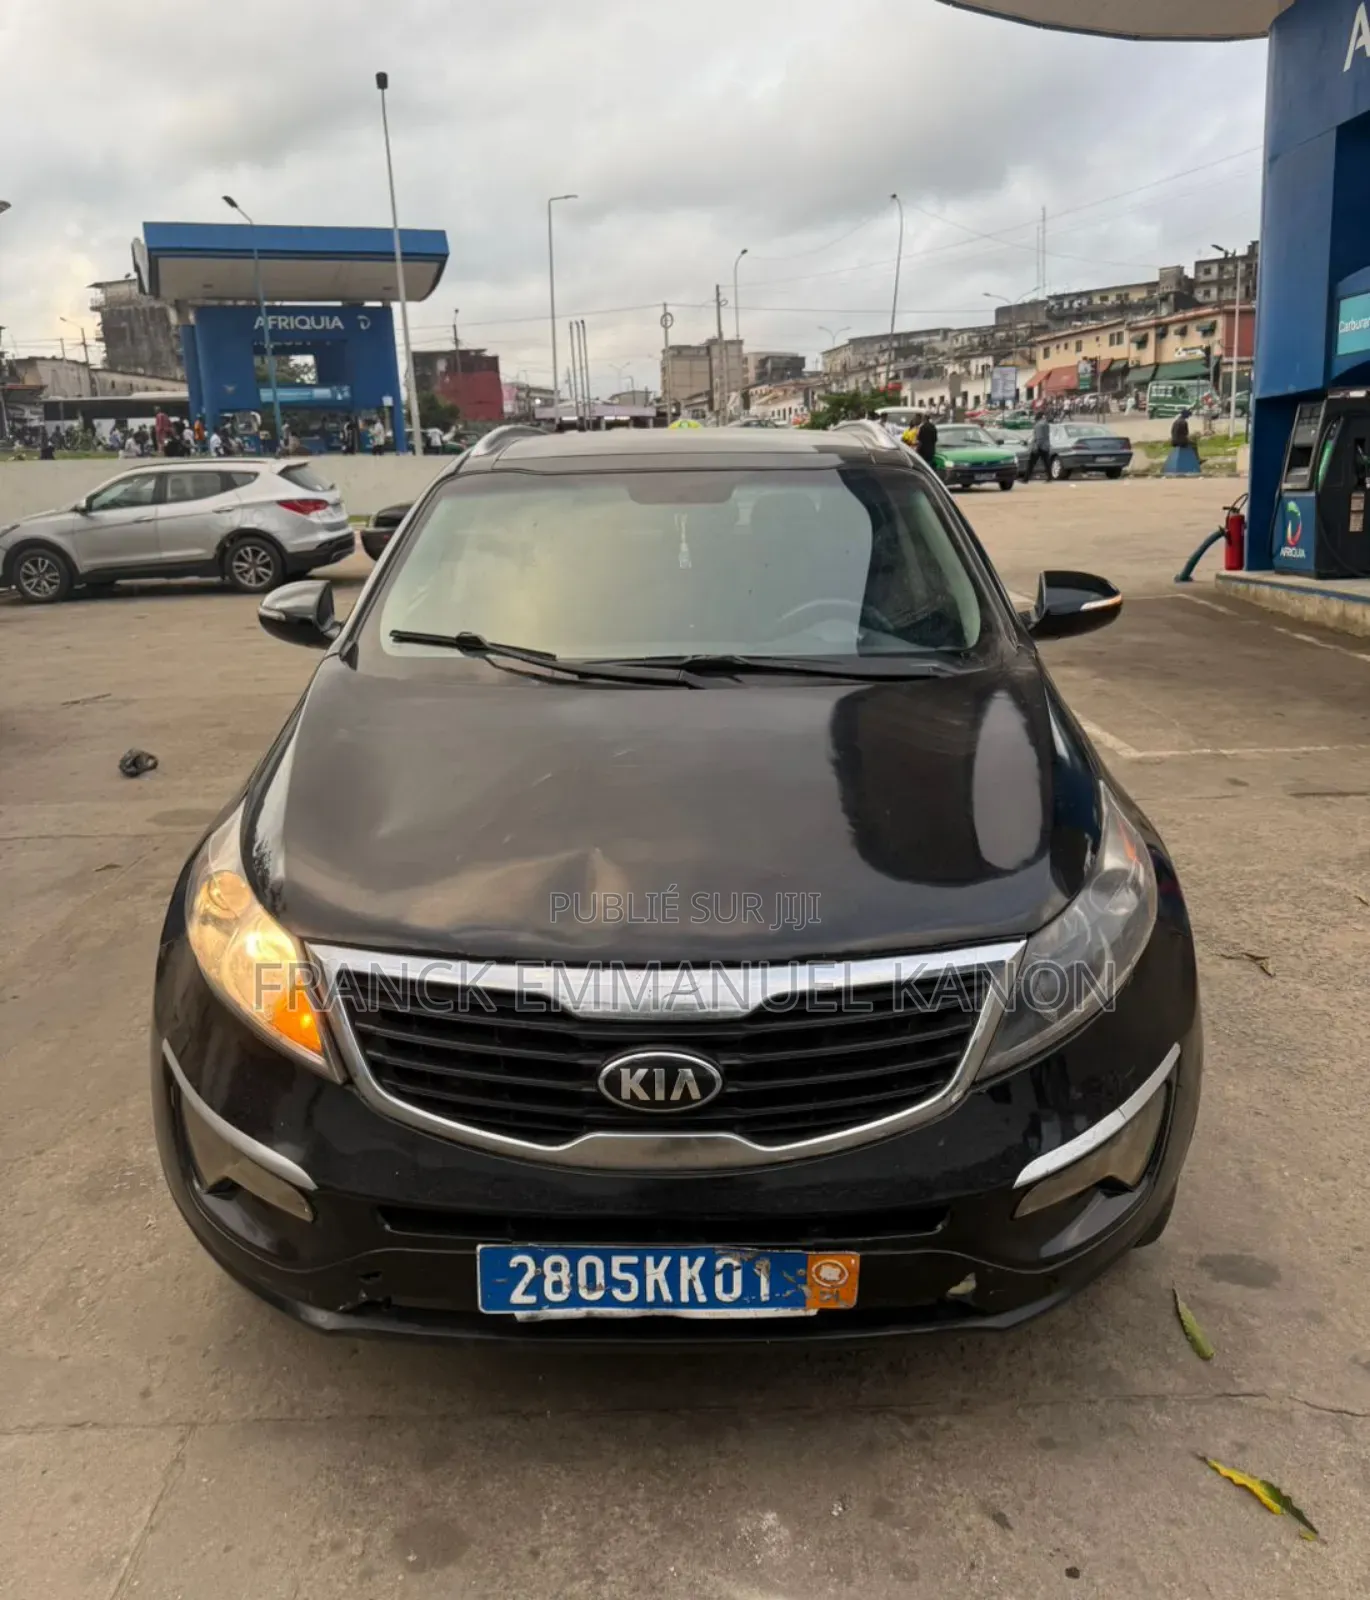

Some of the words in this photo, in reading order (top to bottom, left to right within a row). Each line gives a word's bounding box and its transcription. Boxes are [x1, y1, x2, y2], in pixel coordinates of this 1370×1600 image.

[253, 315, 345, 330] AFRIQUIA
[619, 1068, 702, 1101] KIA
[508, 1254, 772, 1305] 2805KK01
